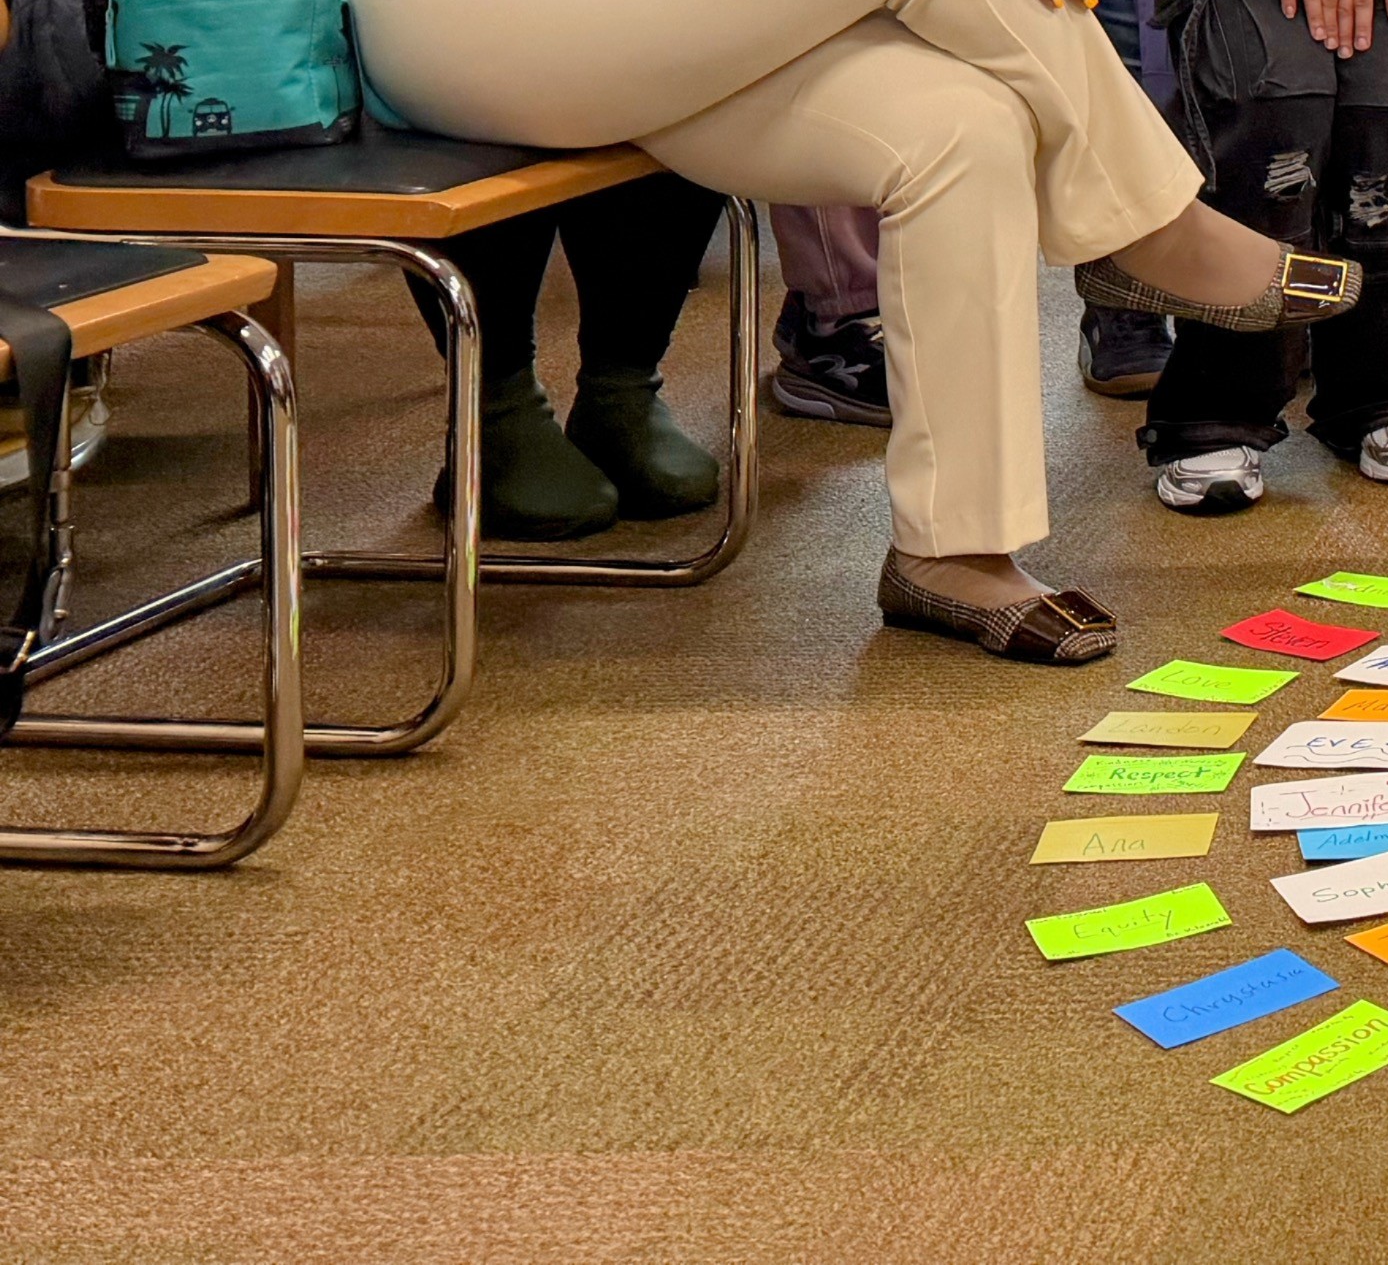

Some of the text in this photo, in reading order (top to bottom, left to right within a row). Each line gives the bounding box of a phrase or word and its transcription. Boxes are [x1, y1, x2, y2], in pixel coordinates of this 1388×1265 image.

[1249, 620, 1332, 652] Steven
[1161, 669, 1233, 690] Love
[1108, 716, 1222, 736] Landon
[1306, 736, 1375, 749] EVE
[1108, 766, 1212, 783] Respect
[1083, 832, 1146, 856] Ana
[1073, 908, 1173, 939] Equity
